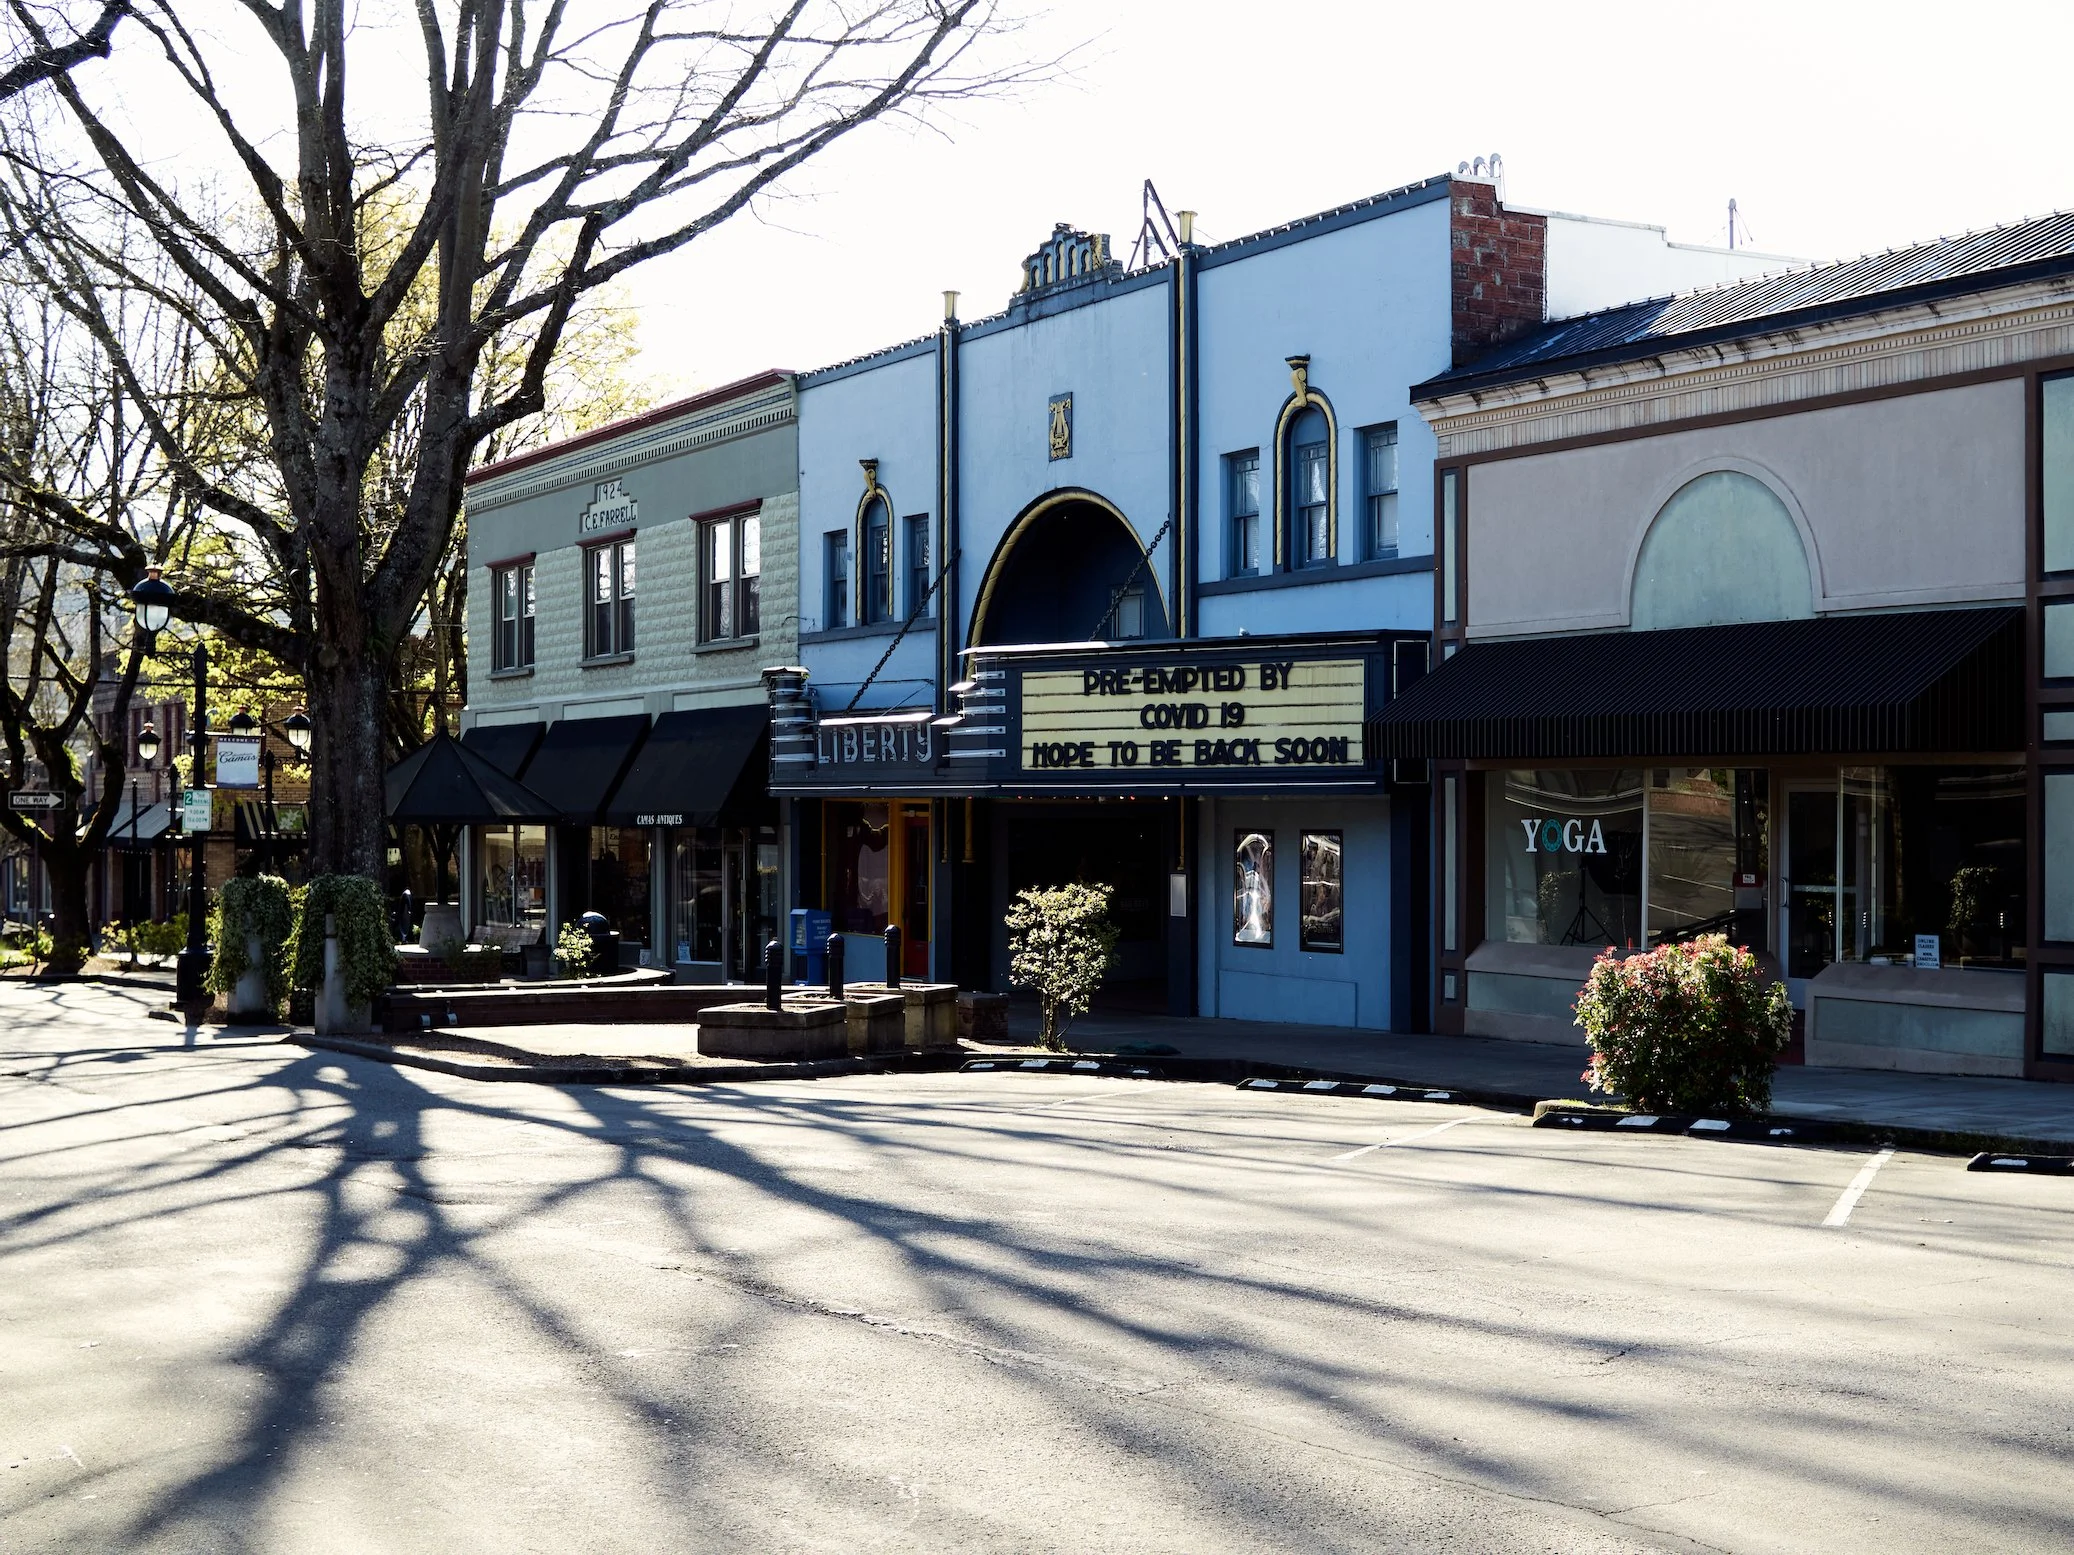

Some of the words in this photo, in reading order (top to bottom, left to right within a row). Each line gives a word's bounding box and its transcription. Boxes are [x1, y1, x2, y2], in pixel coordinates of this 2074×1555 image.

[598, 481, 622, 502] 1924
[1083, 664, 1245, 696] PRE-EMPTED
[1260, 662, 1294, 690] BY
[1140, 703, 1209, 730] COVID
[1220, 702, 1245, 728] 19
[817, 721, 933, 764] LIBERTY
[1032, 741, 1095, 768] HOPE
[1107, 741, 1138, 767] TO
[1150, 740, 1182, 766] BE
[1194, 738, 1261, 766] BACK
[1274, 736, 1348, 765] SOON
[218, 751, 257, 764] Camas
[14, 796, 30, 804] ONE
[32, 796, 48, 804] WAY
[185, 793, 192, 804] 2
[636, 814, 655, 825] CAMAS
[656, 814, 683, 826] ANTIQUES
[1520, 818, 1608, 854] YOGA
